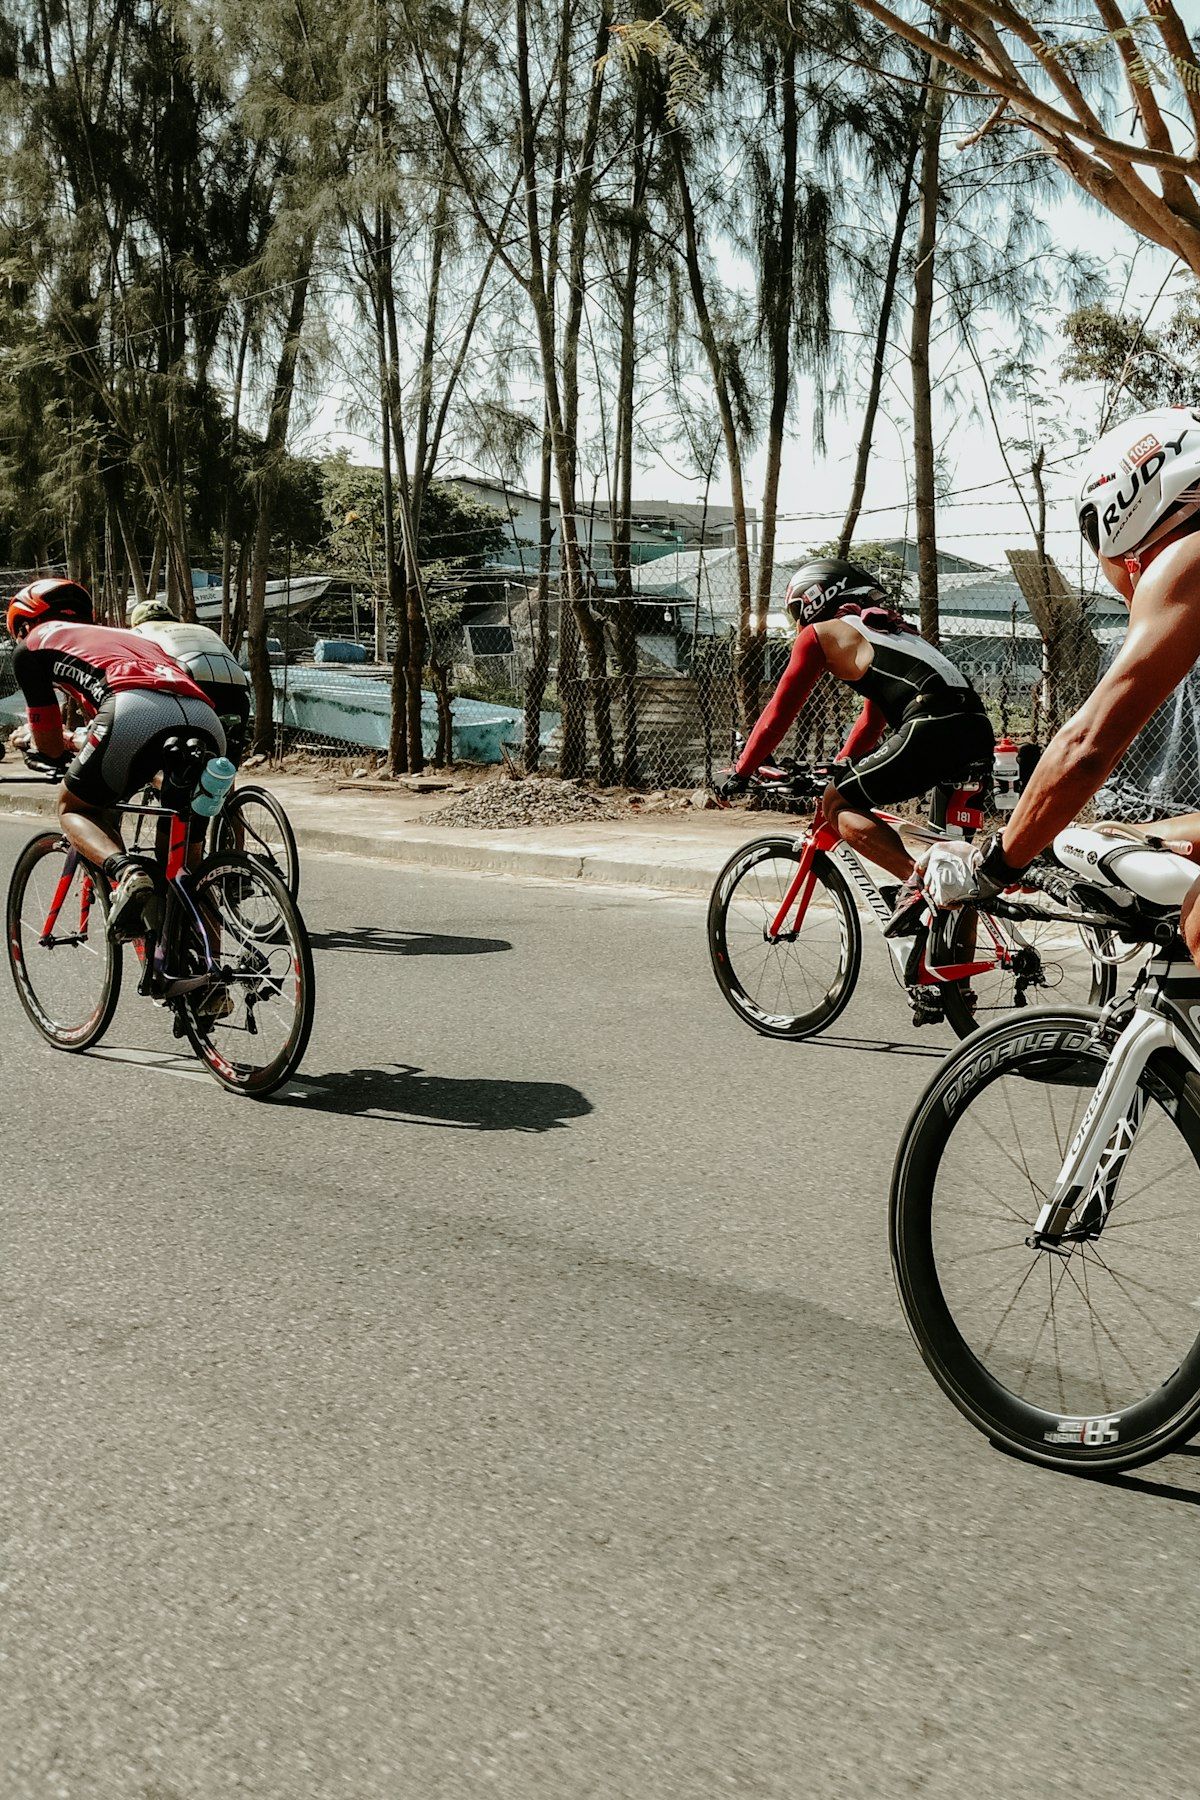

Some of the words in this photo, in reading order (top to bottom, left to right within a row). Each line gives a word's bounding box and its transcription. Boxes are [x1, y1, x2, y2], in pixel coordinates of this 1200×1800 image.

[1129, 435, 1157, 461] 1036
[1103, 430, 1189, 537] RUDY
[1112, 497, 1143, 544] PROJECT
[802, 576, 848, 619] RUDY
[858, 746, 889, 767] orca
[956, 811, 971, 824] 181
[942, 1030, 1062, 1119] PROFILE
